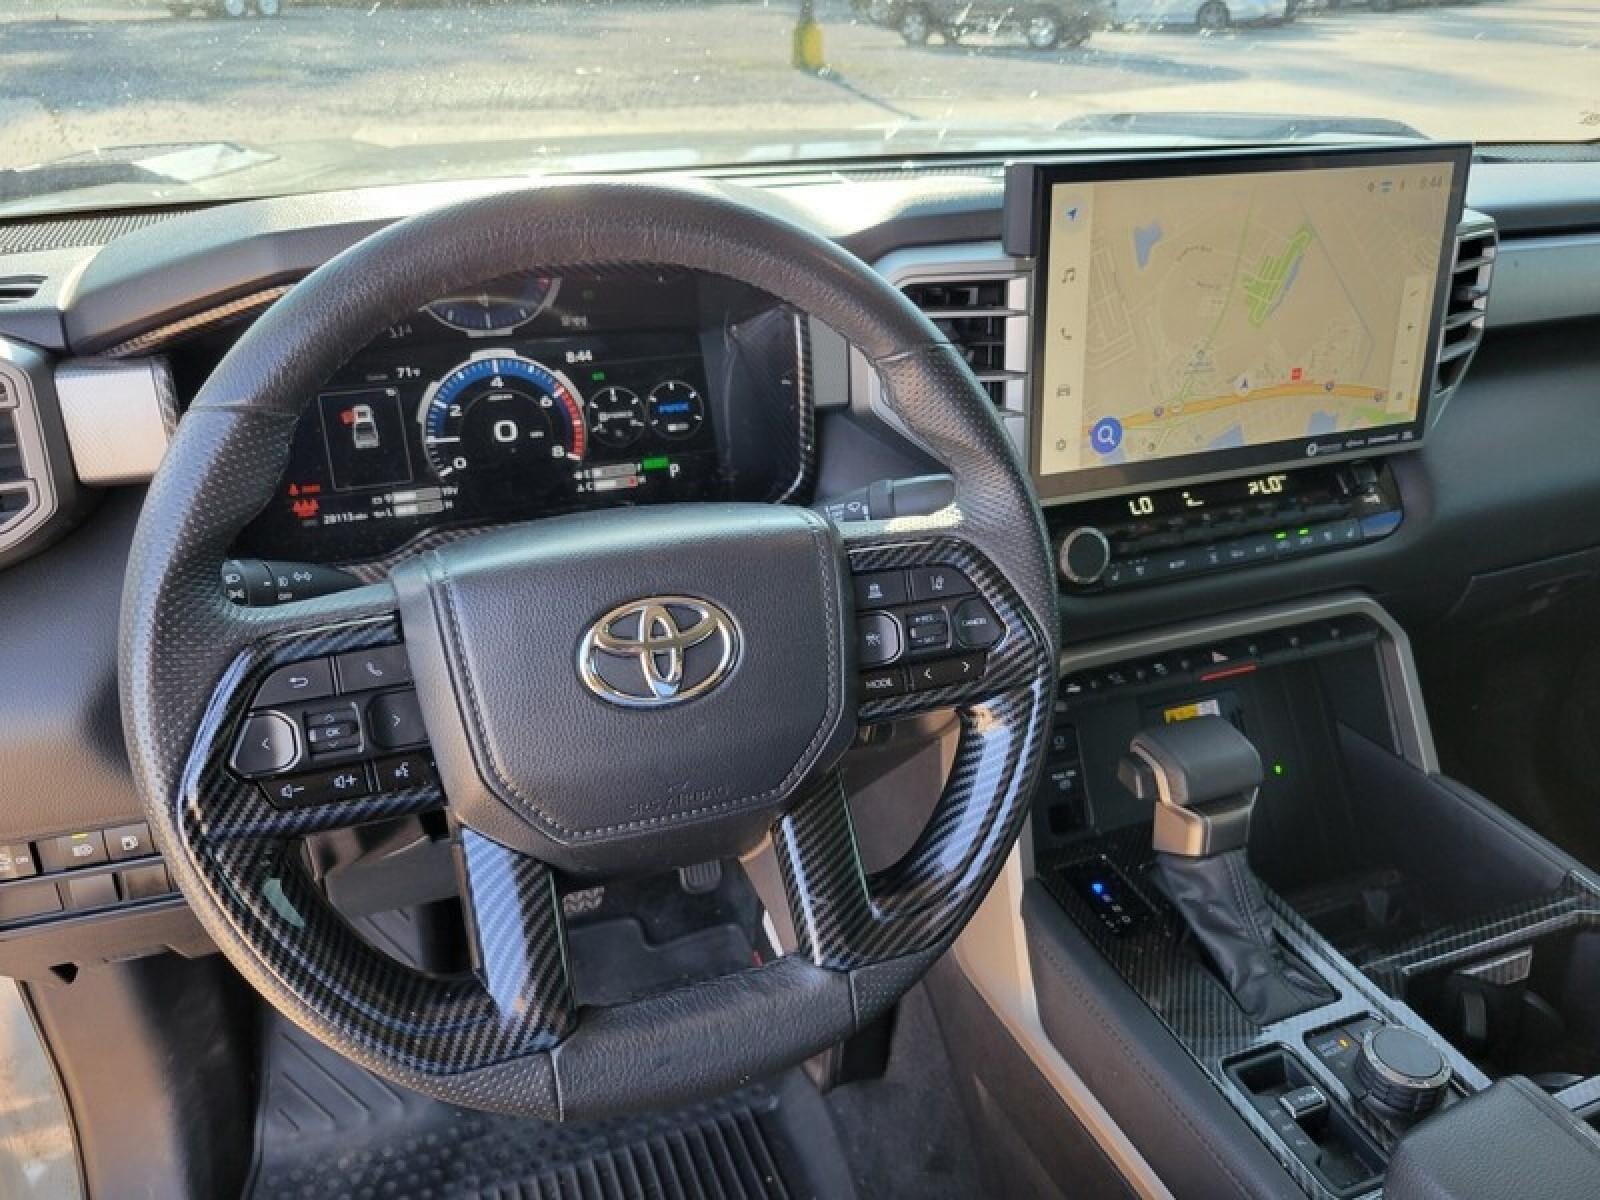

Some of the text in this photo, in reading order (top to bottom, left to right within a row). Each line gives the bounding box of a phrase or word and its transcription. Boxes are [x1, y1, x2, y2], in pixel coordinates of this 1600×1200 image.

[490, 377, 504, 388] 4
[450, 405, 462, 417] 2
[493, 420, 518, 442] 0
[453, 457, 467, 469] 0
[669, 463, 680, 478] P
[1128, 496, 1154, 515] LO
